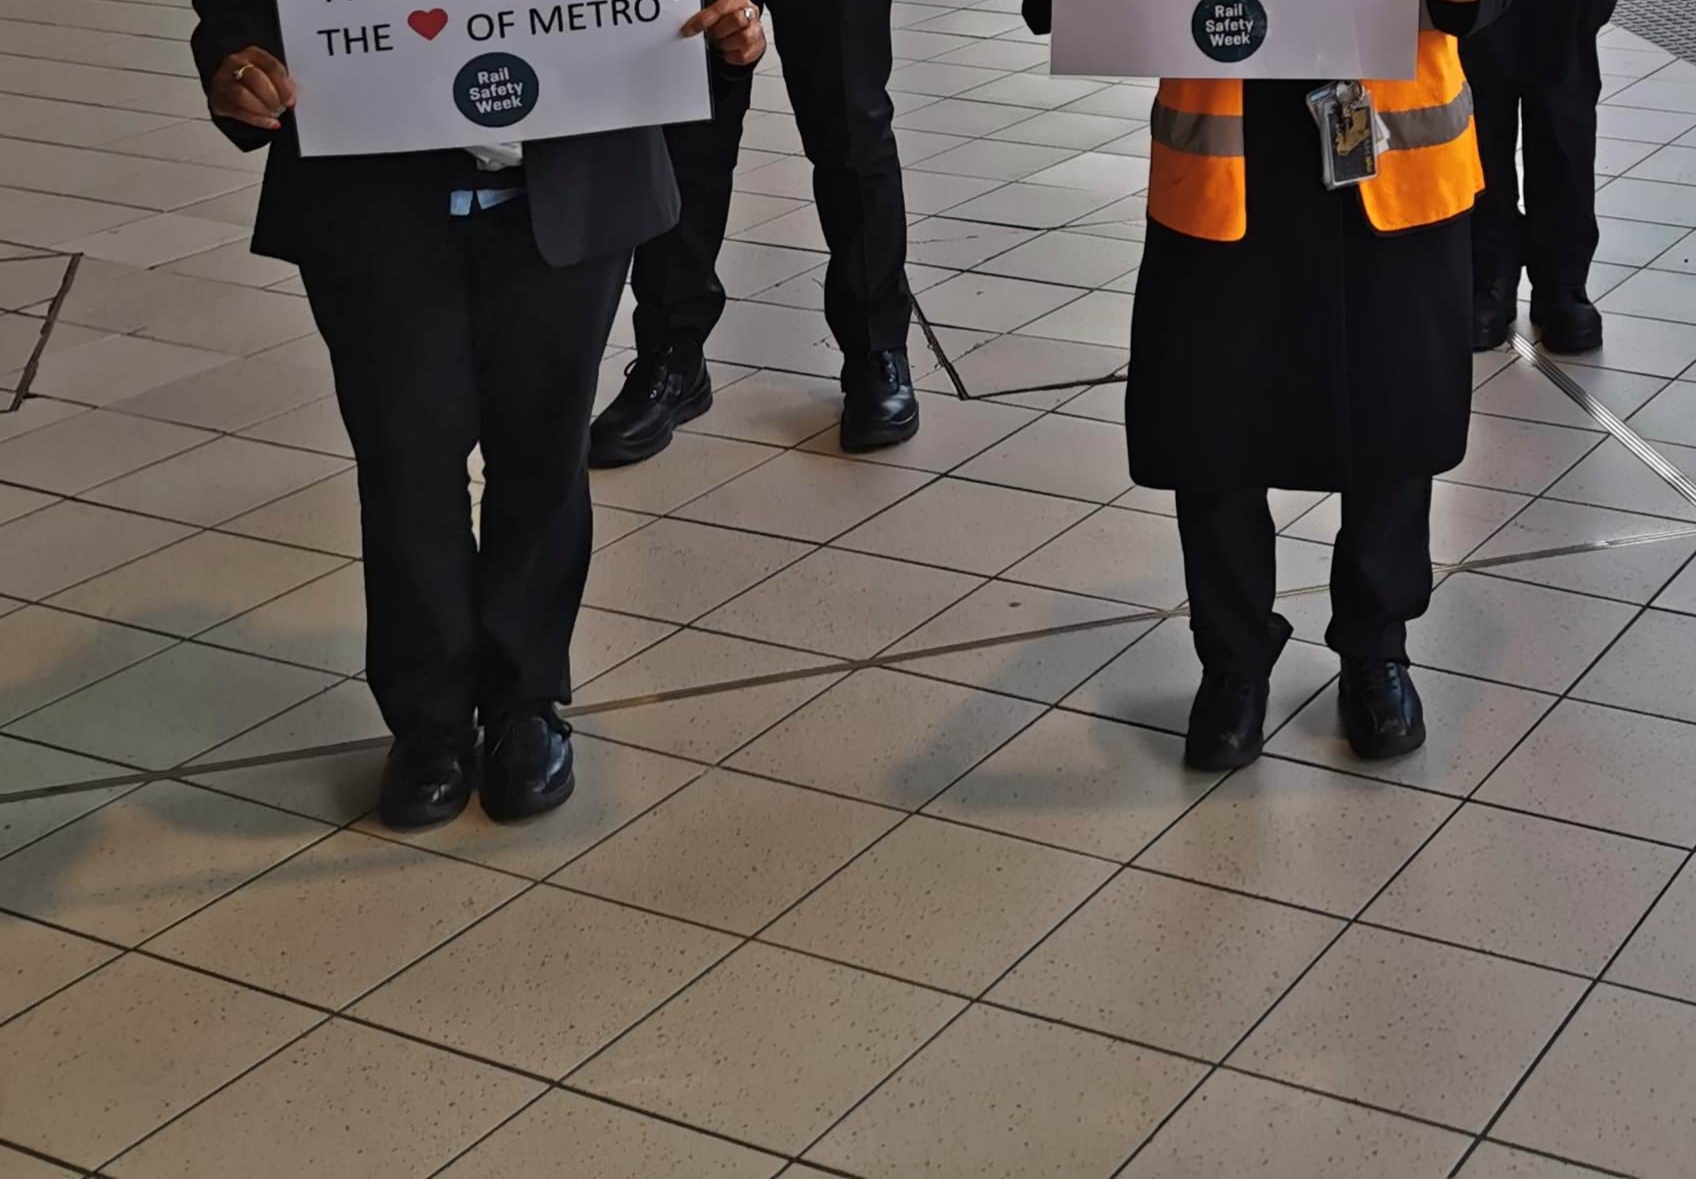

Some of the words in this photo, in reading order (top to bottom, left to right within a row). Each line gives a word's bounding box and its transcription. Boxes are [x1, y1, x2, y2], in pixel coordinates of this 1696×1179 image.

[1214, 4, 1243, 19] Rail
[317, 23, 394, 57] THE
[466, 9, 515, 43] OF
[1205, 18, 1254, 35] Safety
[1209, 32, 1251, 48] Week
[477, 66, 510, 86] Rail
[469, 80, 523, 102] Safety
[475, 94, 523, 115] Week
